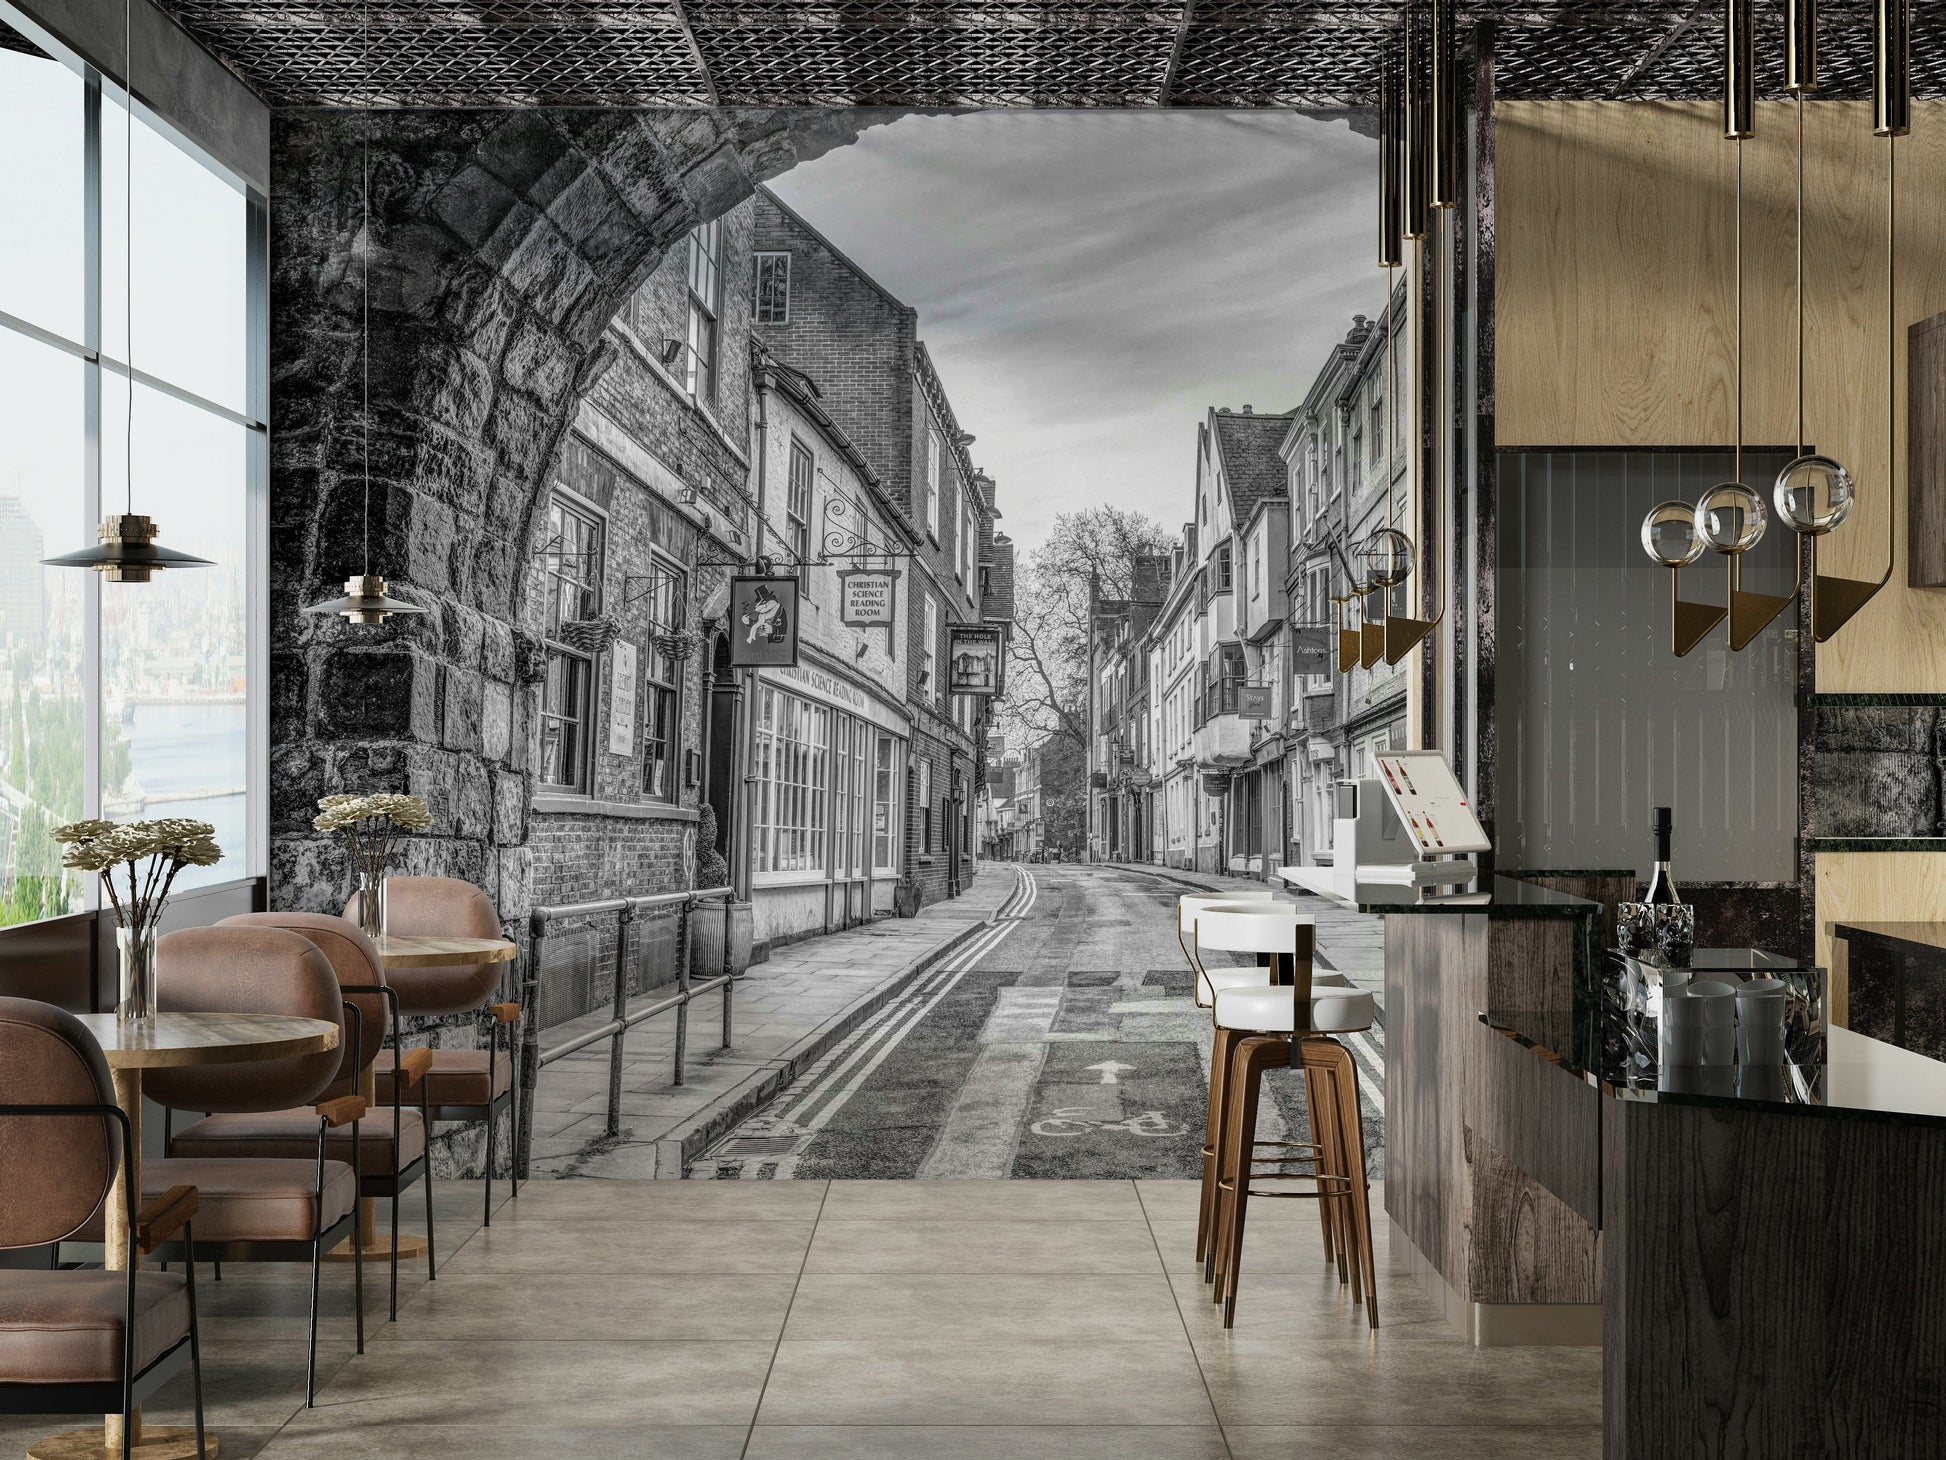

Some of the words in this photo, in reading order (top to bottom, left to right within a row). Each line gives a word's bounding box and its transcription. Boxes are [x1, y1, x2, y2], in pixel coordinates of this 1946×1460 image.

[847, 581, 889, 589] CHRISTIAN
[852, 590, 884, 598] SCIENCE
[850, 599, 886, 607] READING
[811, 671, 832, 695] SCIENCE
